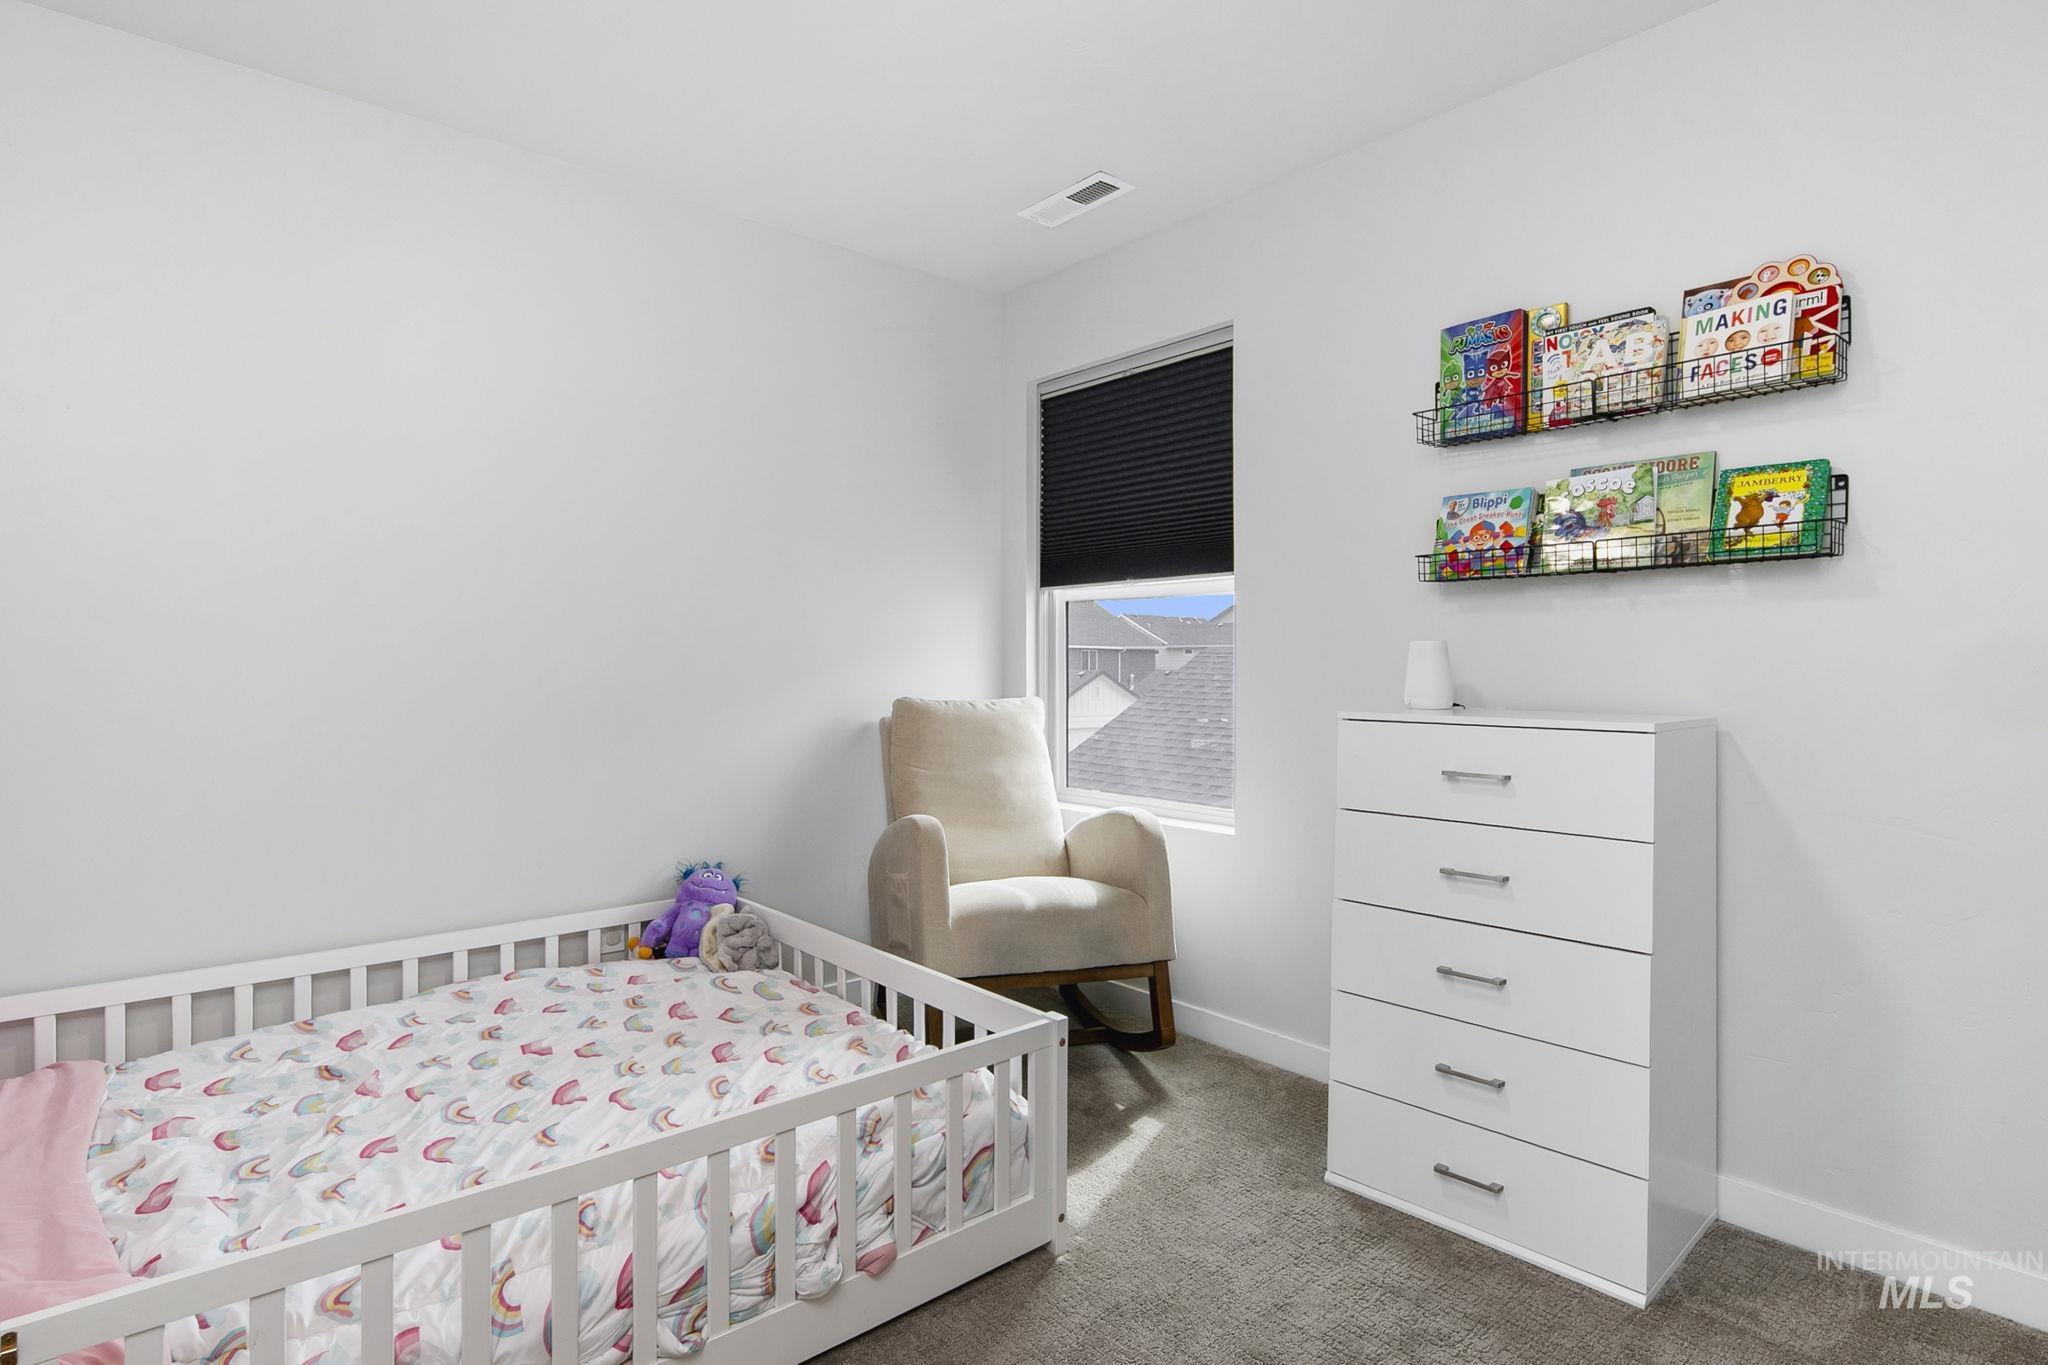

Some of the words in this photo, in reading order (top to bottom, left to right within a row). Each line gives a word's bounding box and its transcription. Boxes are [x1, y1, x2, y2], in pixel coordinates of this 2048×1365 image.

[1569, 323, 1587, 331] TOUCH
[1611, 314, 1631, 323] SOUND
[1632, 310, 1649, 319] BOOK
[1695, 298, 1787, 336] MAKING
[1690, 353, 1757, 382] FACES
[1736, 475, 1803, 488] JAMBERRY
[1472, 494, 1508, 511] Blippi
[1459, 515, 1477, 525] Great
